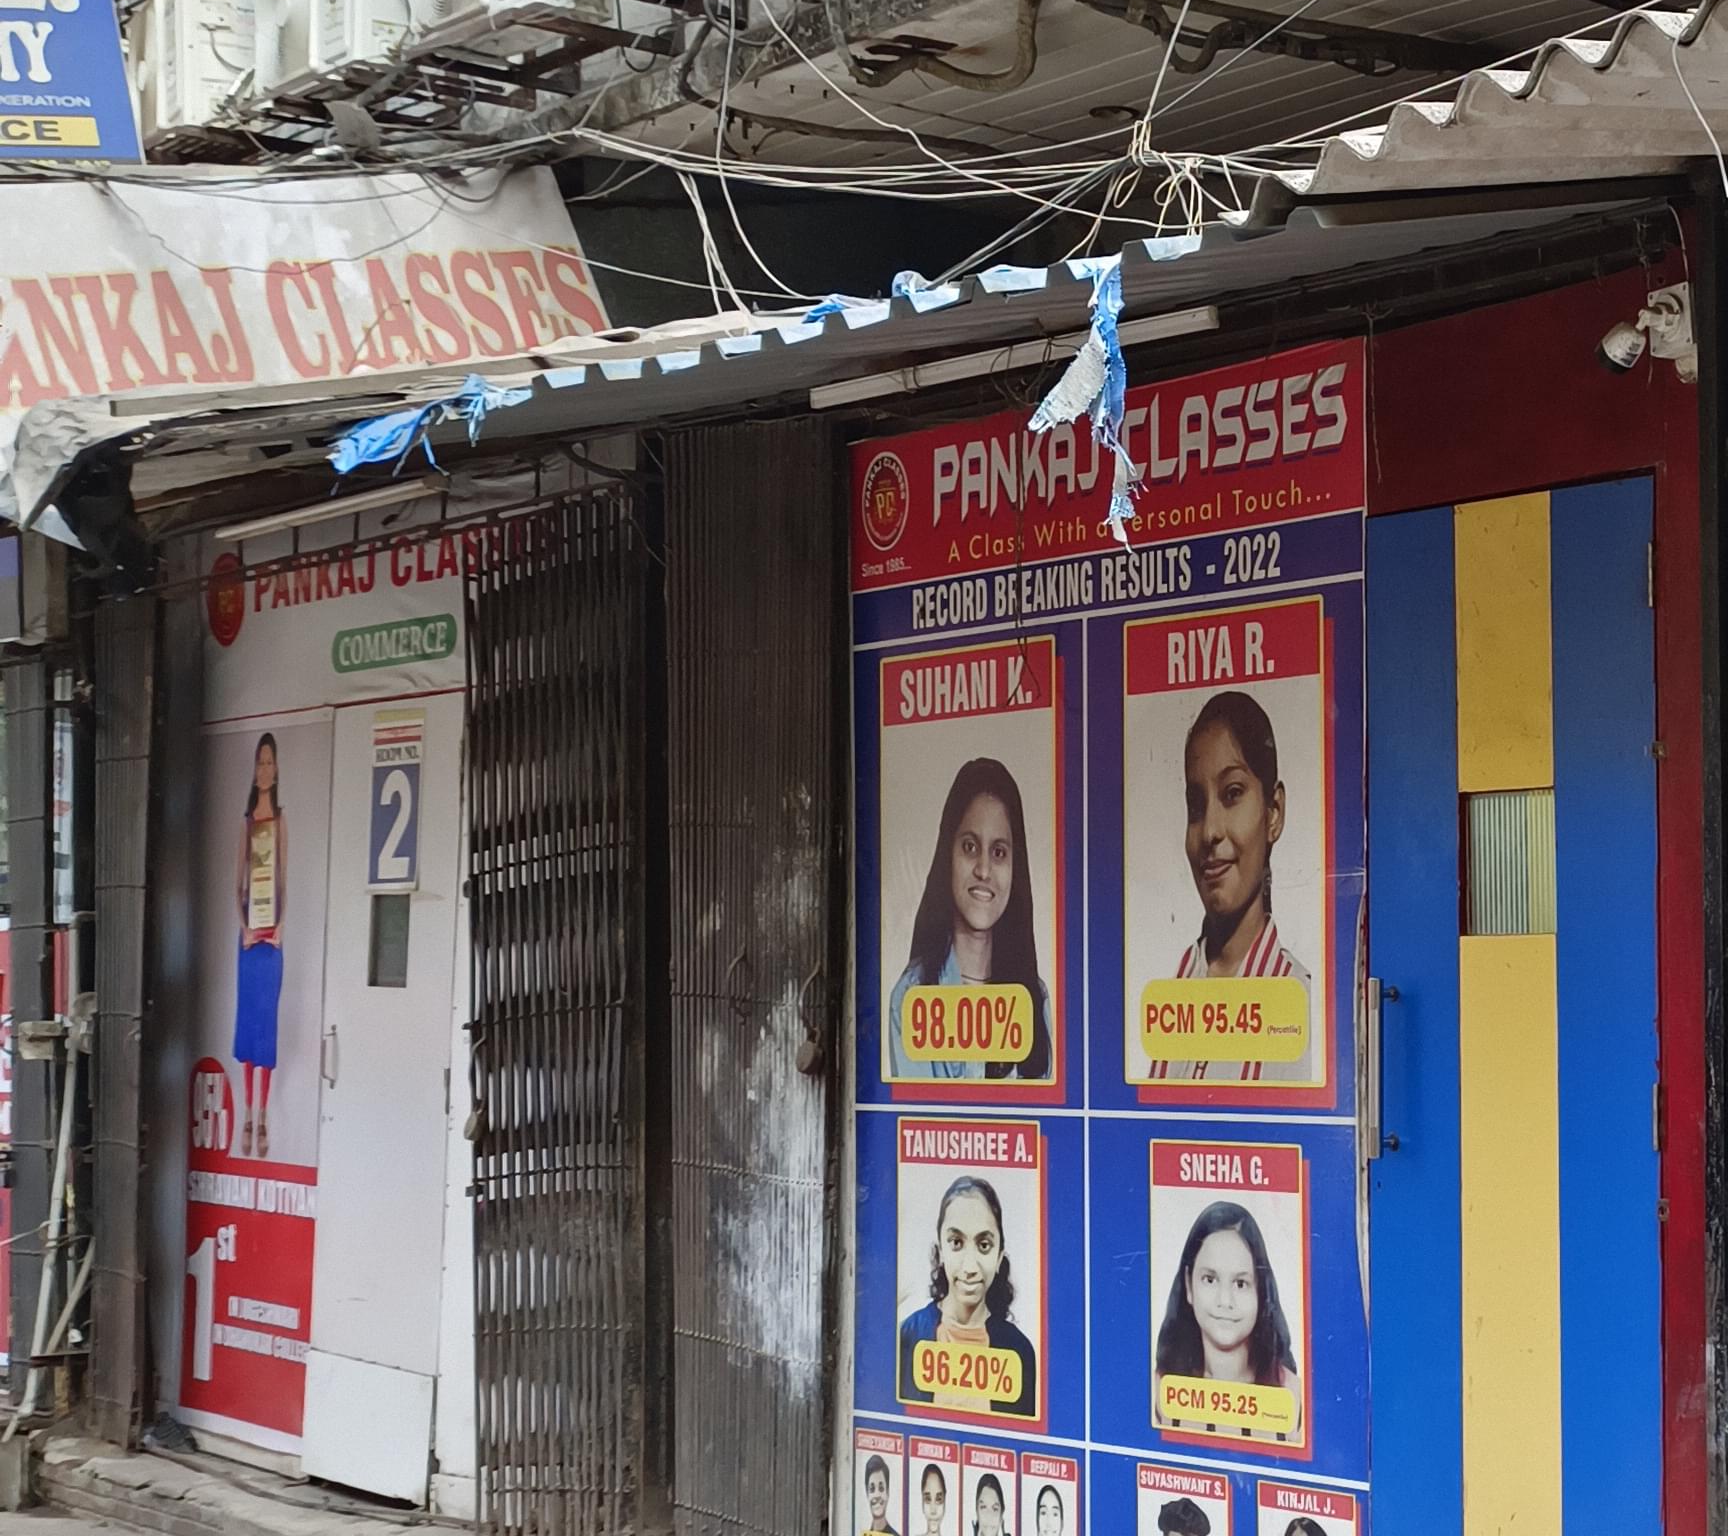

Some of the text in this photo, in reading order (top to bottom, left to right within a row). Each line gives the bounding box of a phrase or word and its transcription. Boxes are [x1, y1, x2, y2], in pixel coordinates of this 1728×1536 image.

[0, 119, 62, 142] CE
[265, 244, 611, 378] CLASSES
[932, 362, 1349, 527] PANKAJ CLASSES
[948, 540, 961, 563] A
[1034, 517, 1087, 547] With
[1124, 501, 1223, 533] ersonal
[1232, 479, 1332, 513] Touch...
[254, 542, 376, 613] PANKAJ
[912, 579, 988, 630] RECORD
[994, 561, 1093, 618] BREAKING
[1101, 545, 1192, 602] RESULTS
[1223, 531, 1281, 585] 2022
[338, 621, 449, 667] COMMERCE
[1167, 621, 1275, 685] RIYA R.
[899, 656, 1033, 719] SUHANI K.
[377, 769, 412, 880] 2
[911, 995, 1022, 1051] 98.00%
[1146, 1003, 1195, 1035] PCM
[1202, 1002, 1262, 1035] 95.45
[903, 1128, 1034, 1163] TANUSHREE A.
[1180, 1152, 1270, 1186] SNEHA G.
[921, 1348, 1013, 1395] 96.20%
[1166, 1385, 1205, 1409] PCM
[1210, 1392, 1258, 1417] 95.25
[1214, 1481, 1225, 1497] S.
[1276, 1490, 1336, 1514] KINJAL J.
